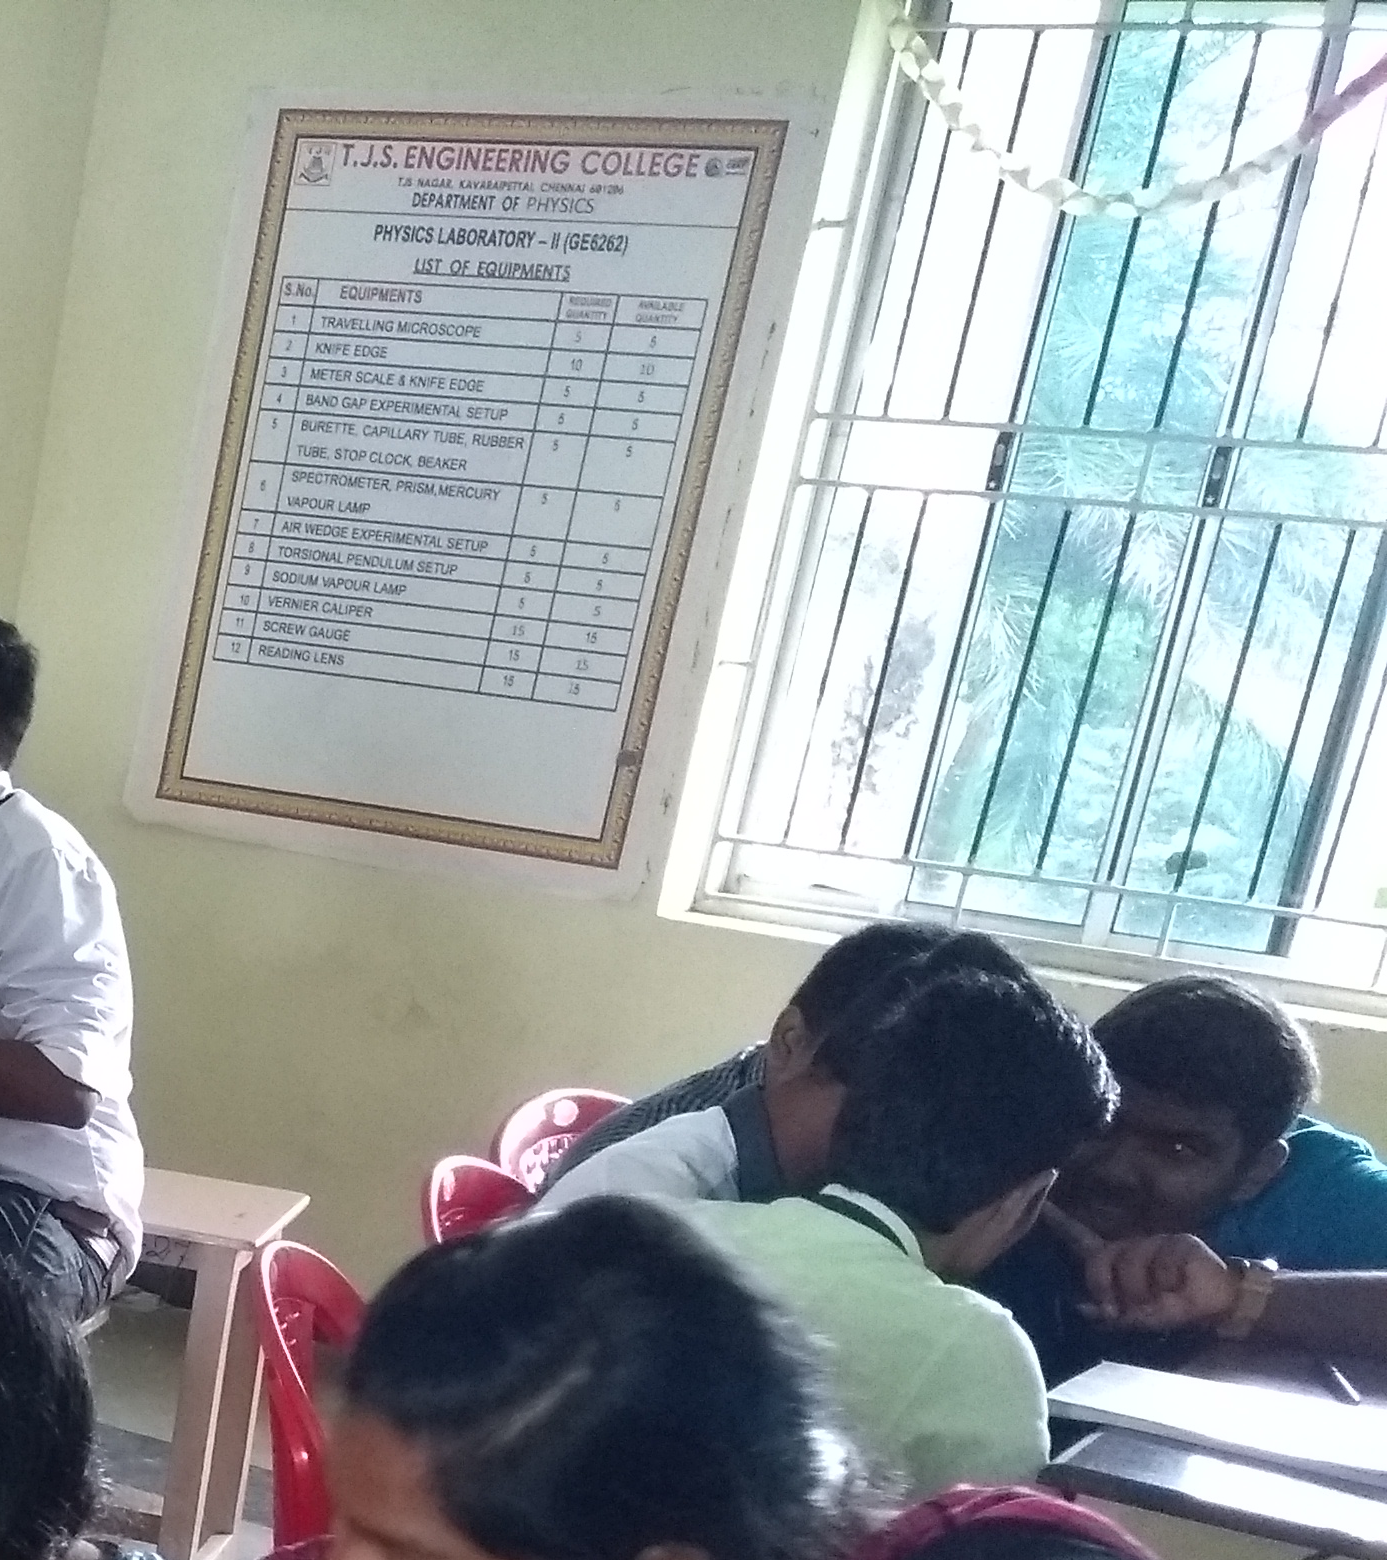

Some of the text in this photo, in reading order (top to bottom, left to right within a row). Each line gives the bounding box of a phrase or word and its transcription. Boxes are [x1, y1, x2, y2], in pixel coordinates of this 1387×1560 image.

[342, 143, 399, 170] T.J.S.
[404, 145, 571, 175] ENGINEERING
[581, 149, 701, 178] COLLEGE
[411, 192, 595, 214] DEPARTMENT OF PHYSICS
[373, 224, 434, 244] PHYSICS
[437, 227, 537, 249] LABORATORY
[550, 232, 561, 250] II
[563, 233, 629, 257] (GE6262)
[413, 257, 571, 282] LIST OF EQUIPMENTS
[339, 285, 423, 304] EQUIPMENTS
[291, 314, 297, 326] 1
[321, 315, 482, 339] TRAVELLING MICROSCOPE
[285, 339, 293, 351] 2
[315, 341, 389, 359] KNIFE EDGE
[280, 366, 288, 378] 3
[310, 367, 485, 393] METER SCALE & KNIFE EDGE
[275, 392, 283, 404] 4
[306, 394, 509, 421] BAND GAP EXPERIMENTAL SETUP
[271, 418, 278, 430] 5
[362, 424, 428, 441] CAPILLARY
[472, 433, 525, 450] RUBBER
[333, 448, 367, 462] STOP
[417, 456, 468, 471] BEAKER
[260, 480, 267, 492] 6
[287, 496, 372, 515] VAPOUR LAMP
[253, 518, 260, 530] 7
[281, 520, 489, 553] AIR WEDGE EXPERIMENTAL SETUP
[248, 541, 255, 553] 8
[243, 563, 251, 576] 9
[277, 544, 459, 576] TORSIONAL PENDULUM SETUP
[272, 569, 408, 596] SODIUM VAPOUR LAMP
[240, 594, 250, 606] 10
[267, 594, 374, 618] VERNIER CALIPER
[235, 616, 245, 628] 11
[263, 619, 351, 642] SCREW GAUGE
[230, 641, 242, 654] 12
[257, 643, 345, 666] READING LENS
